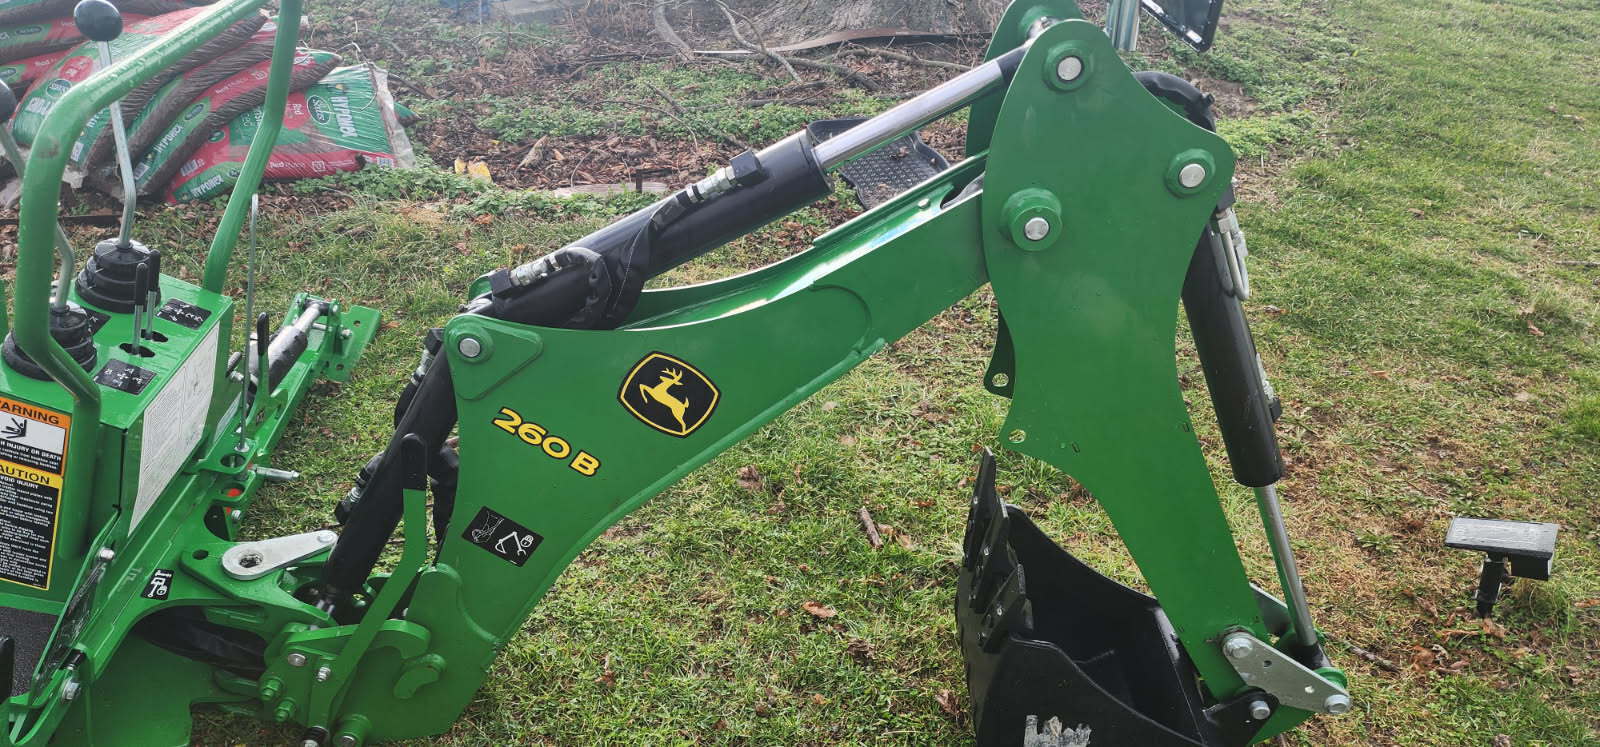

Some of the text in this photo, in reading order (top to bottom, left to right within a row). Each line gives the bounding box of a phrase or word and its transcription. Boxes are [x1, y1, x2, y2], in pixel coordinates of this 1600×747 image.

[0, 399, 59, 424] ARNING
[493, 408, 601, 477] 260 B
